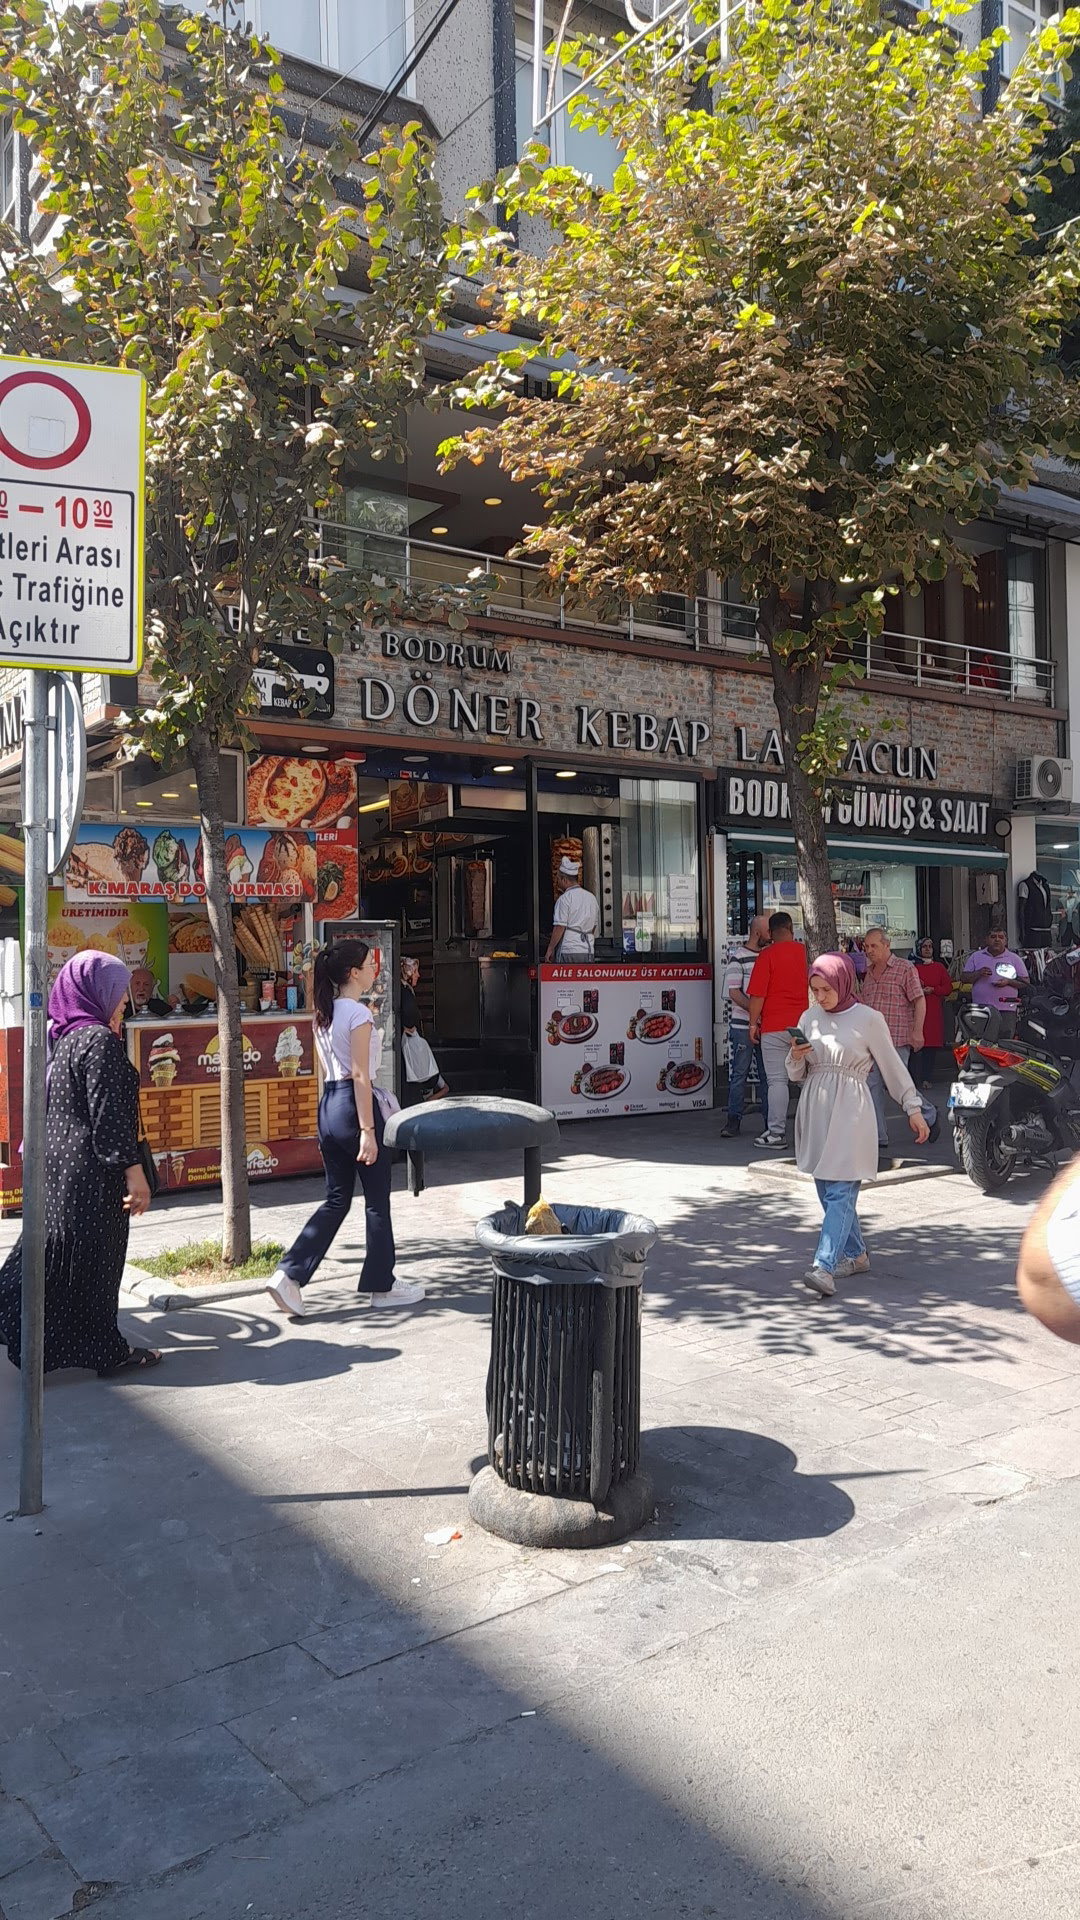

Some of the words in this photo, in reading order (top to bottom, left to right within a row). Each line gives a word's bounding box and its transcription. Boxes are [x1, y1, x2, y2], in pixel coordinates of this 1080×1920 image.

[56, 537, 120, 568] Arası
[12, 573, 124, 612] Trafiğine
[382, 632, 512, 673] BODRUM
[359, 670, 544, 740] DÖNER
[577, 705, 711, 756] KEBAP
[735, 726, 939, 780] LAACUN
[838, 786, 916, 835] GÜMÜŞ
[918, 797, 935, 829] &
[940, 798, 989, 834] SAAT
[88, 881, 177, 899] K.MARAŞ
[552, 967, 573, 977] AİLE
[577, 968, 637, 978] SALONUMUZ
[641, 967, 657, 977] ÜST
